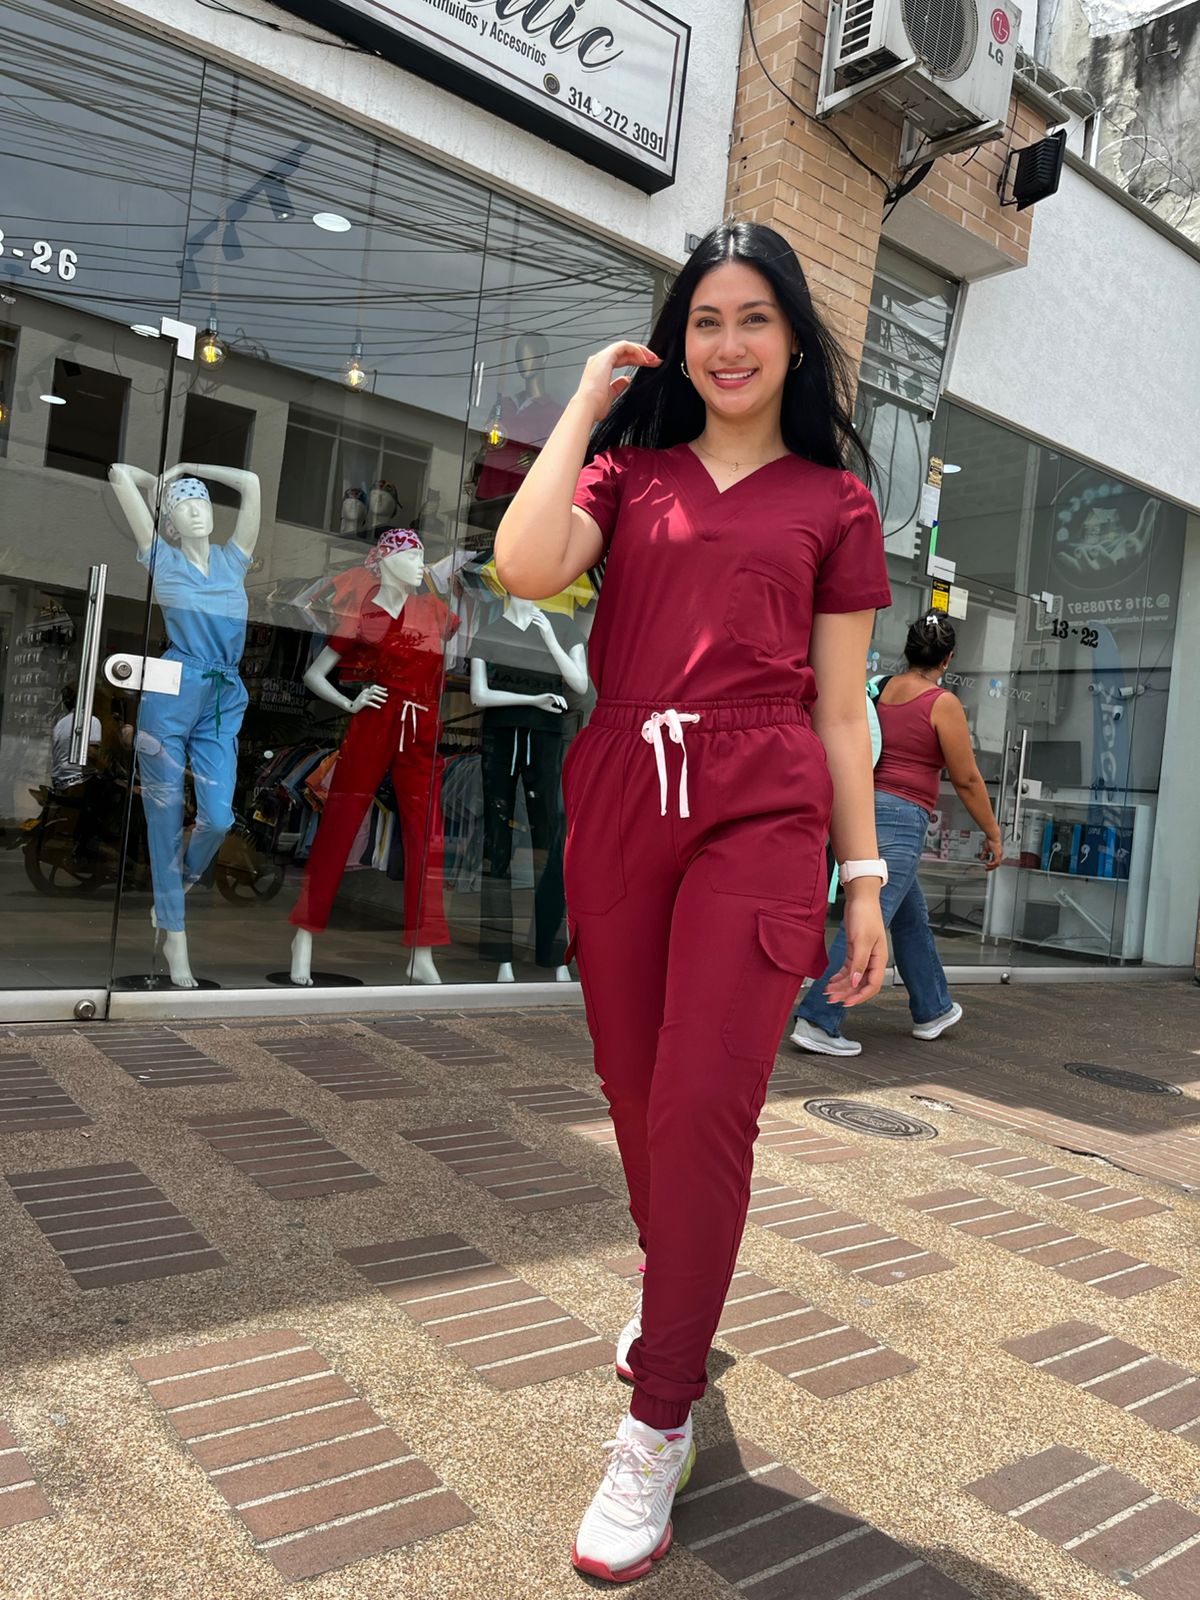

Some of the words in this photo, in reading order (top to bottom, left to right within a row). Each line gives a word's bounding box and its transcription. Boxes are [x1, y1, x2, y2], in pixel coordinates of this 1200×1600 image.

[479, 19, 489, 36] y
[489, 21, 547, 67] Accesorios
[988, 41, 1004, 67] LG
[568, 86, 592, 115] 314
[603, 106, 629, 135] 272
[632, 122, 664, 154] 3091
[945, 672, 977, 689] EZVIZ
[1002, 687, 1032, 702] EZVIZ
